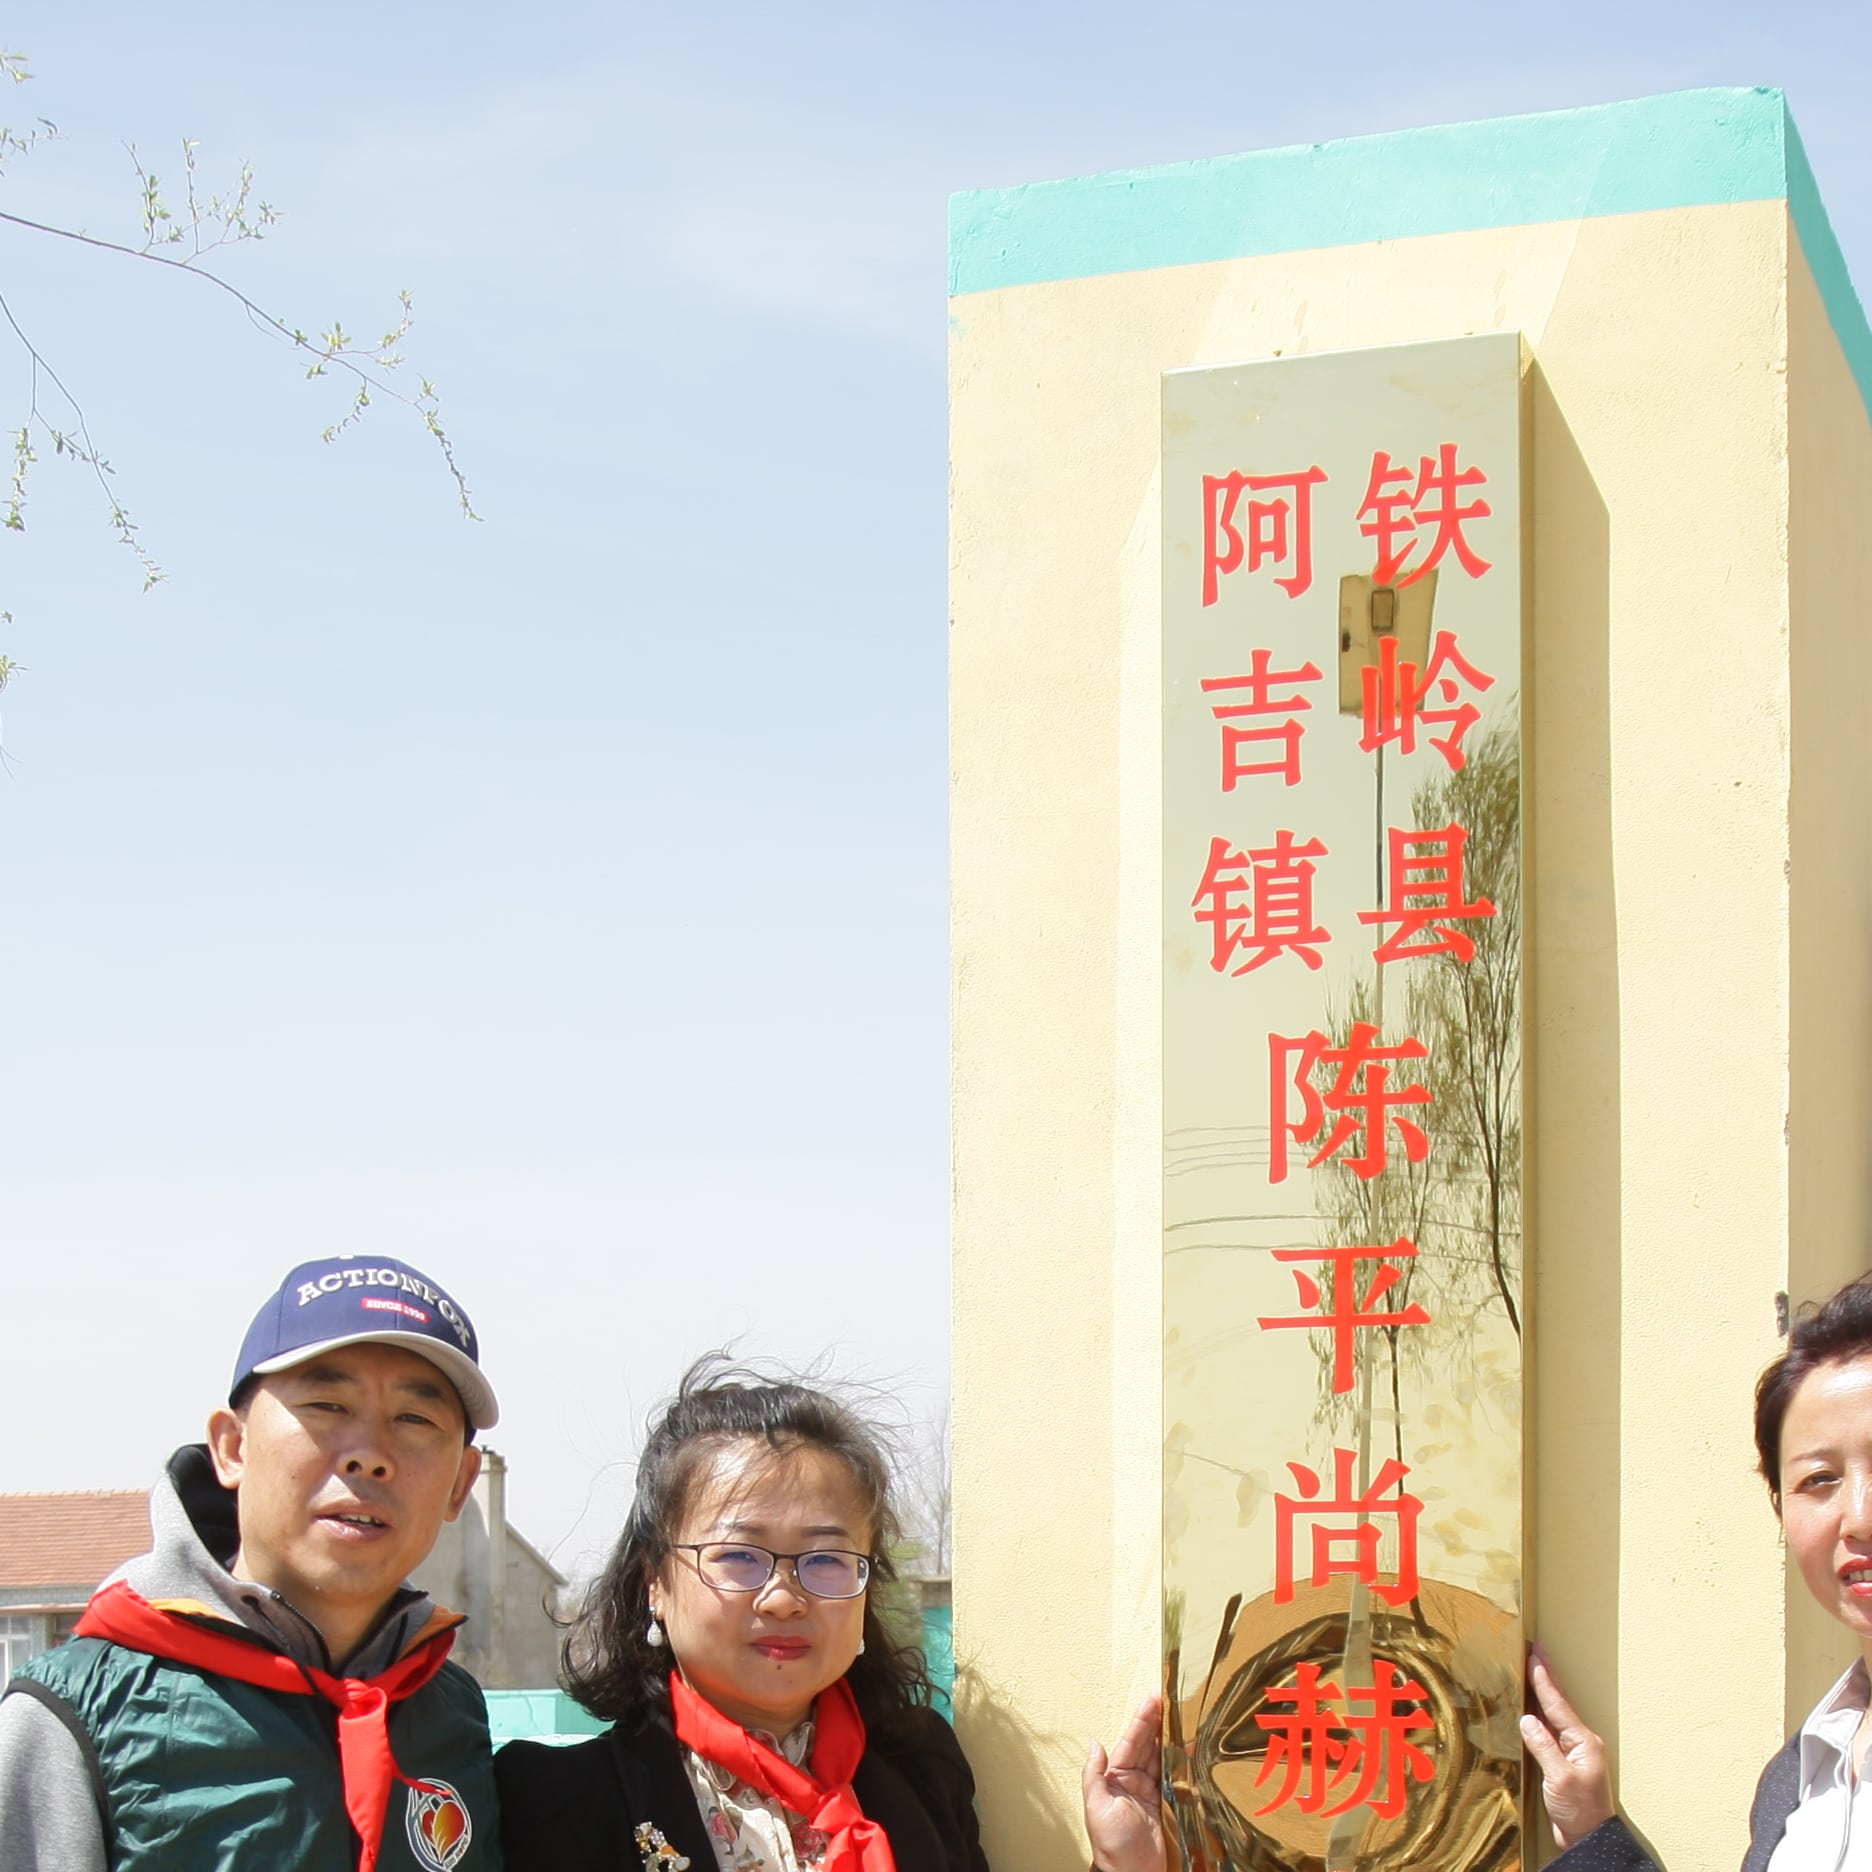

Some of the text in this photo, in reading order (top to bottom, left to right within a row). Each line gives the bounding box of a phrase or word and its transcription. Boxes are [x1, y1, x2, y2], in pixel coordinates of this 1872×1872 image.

[1191, 465, 1332, 977] 阿吉镇
[1357, 443, 1498, 966] 铁岭县
[297, 1268, 471, 1348] ACTIONFOX
